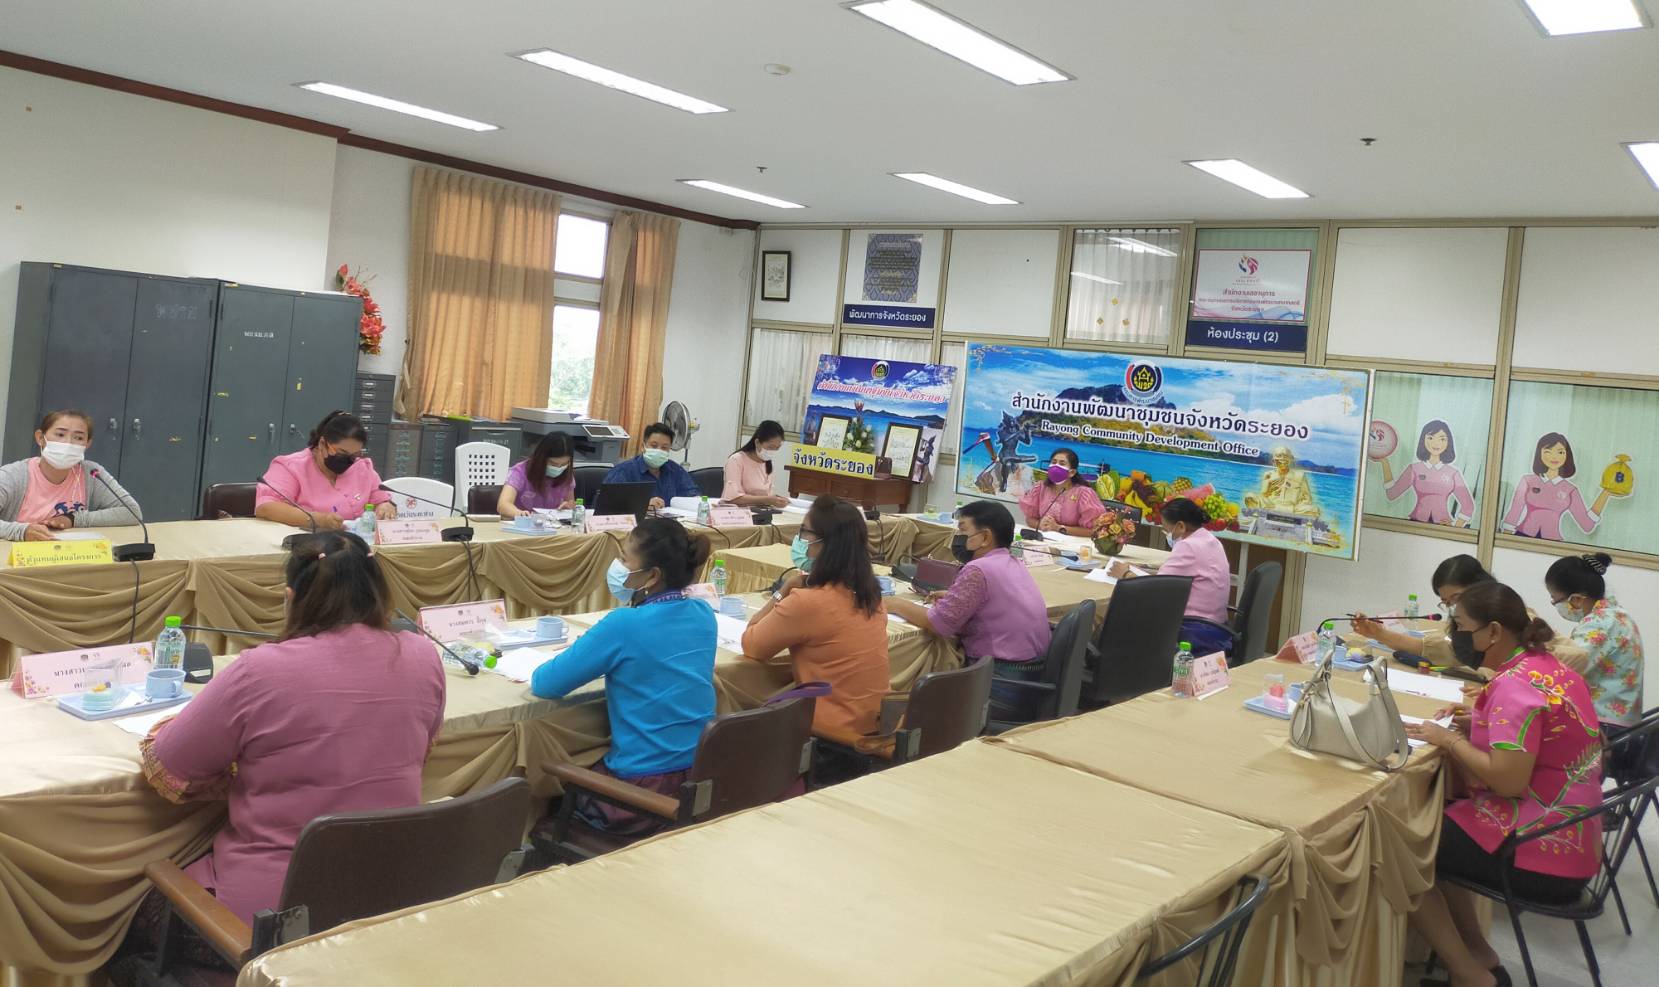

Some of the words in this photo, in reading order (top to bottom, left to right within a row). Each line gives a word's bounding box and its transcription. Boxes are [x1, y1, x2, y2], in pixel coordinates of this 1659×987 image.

[849, 308, 926, 323] พัฒนาการจังหวัดระยอง
[1207, 327, 1260, 343] ห้องประชุม
[1263, 332, 1279, 343] (2)
[1012, 392, 1309, 439] สำนักงานพัฒนาชุมชนจังหวัดระยอง
[1041, 420, 1079, 436] Rayong
[1082, 425, 1143, 443] Community
[1145, 433, 1220, 452] Development
[1223, 442, 1259, 457] Office
[793, 448, 874, 476] จังหวัดระยอง
